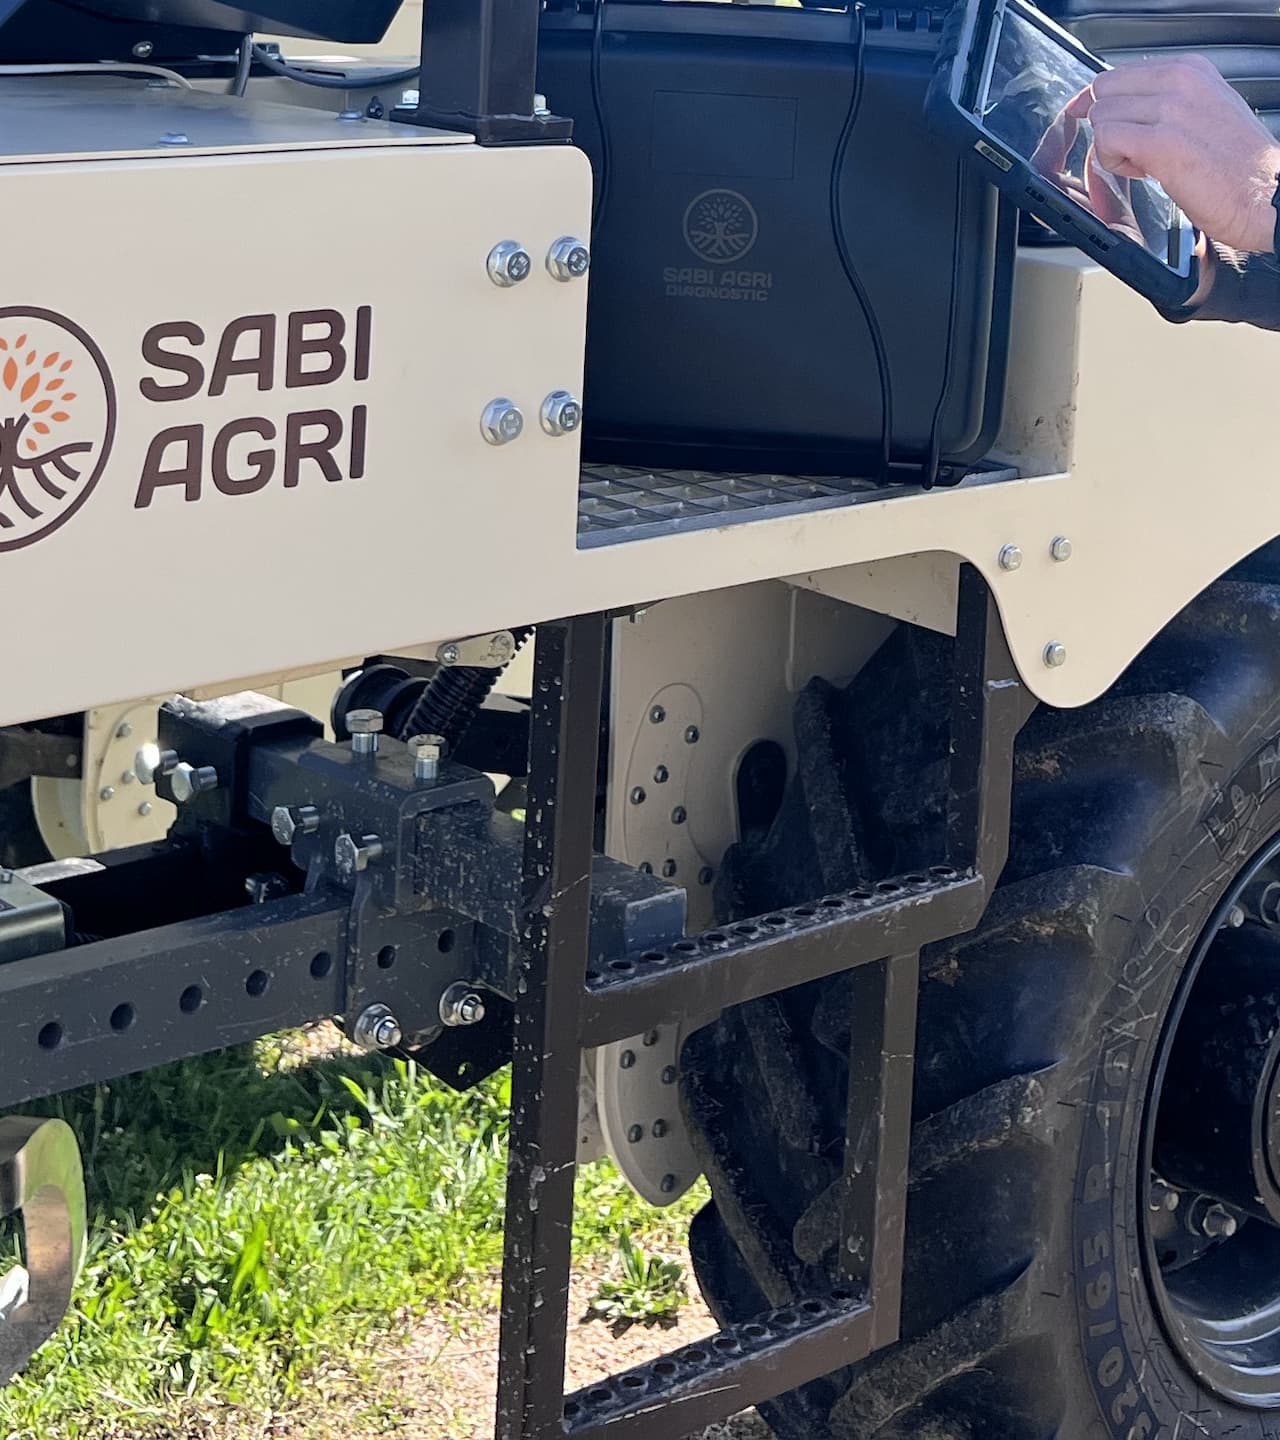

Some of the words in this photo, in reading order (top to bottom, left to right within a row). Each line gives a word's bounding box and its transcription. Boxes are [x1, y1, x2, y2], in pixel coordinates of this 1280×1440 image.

[663, 267, 714, 284] SABI
[721, 270, 772, 288] AGRI
[666, 284, 769, 301] DIAGNOSTIC
[139, 305, 372, 402] SABI
[134, 405, 367, 509] AGRI
